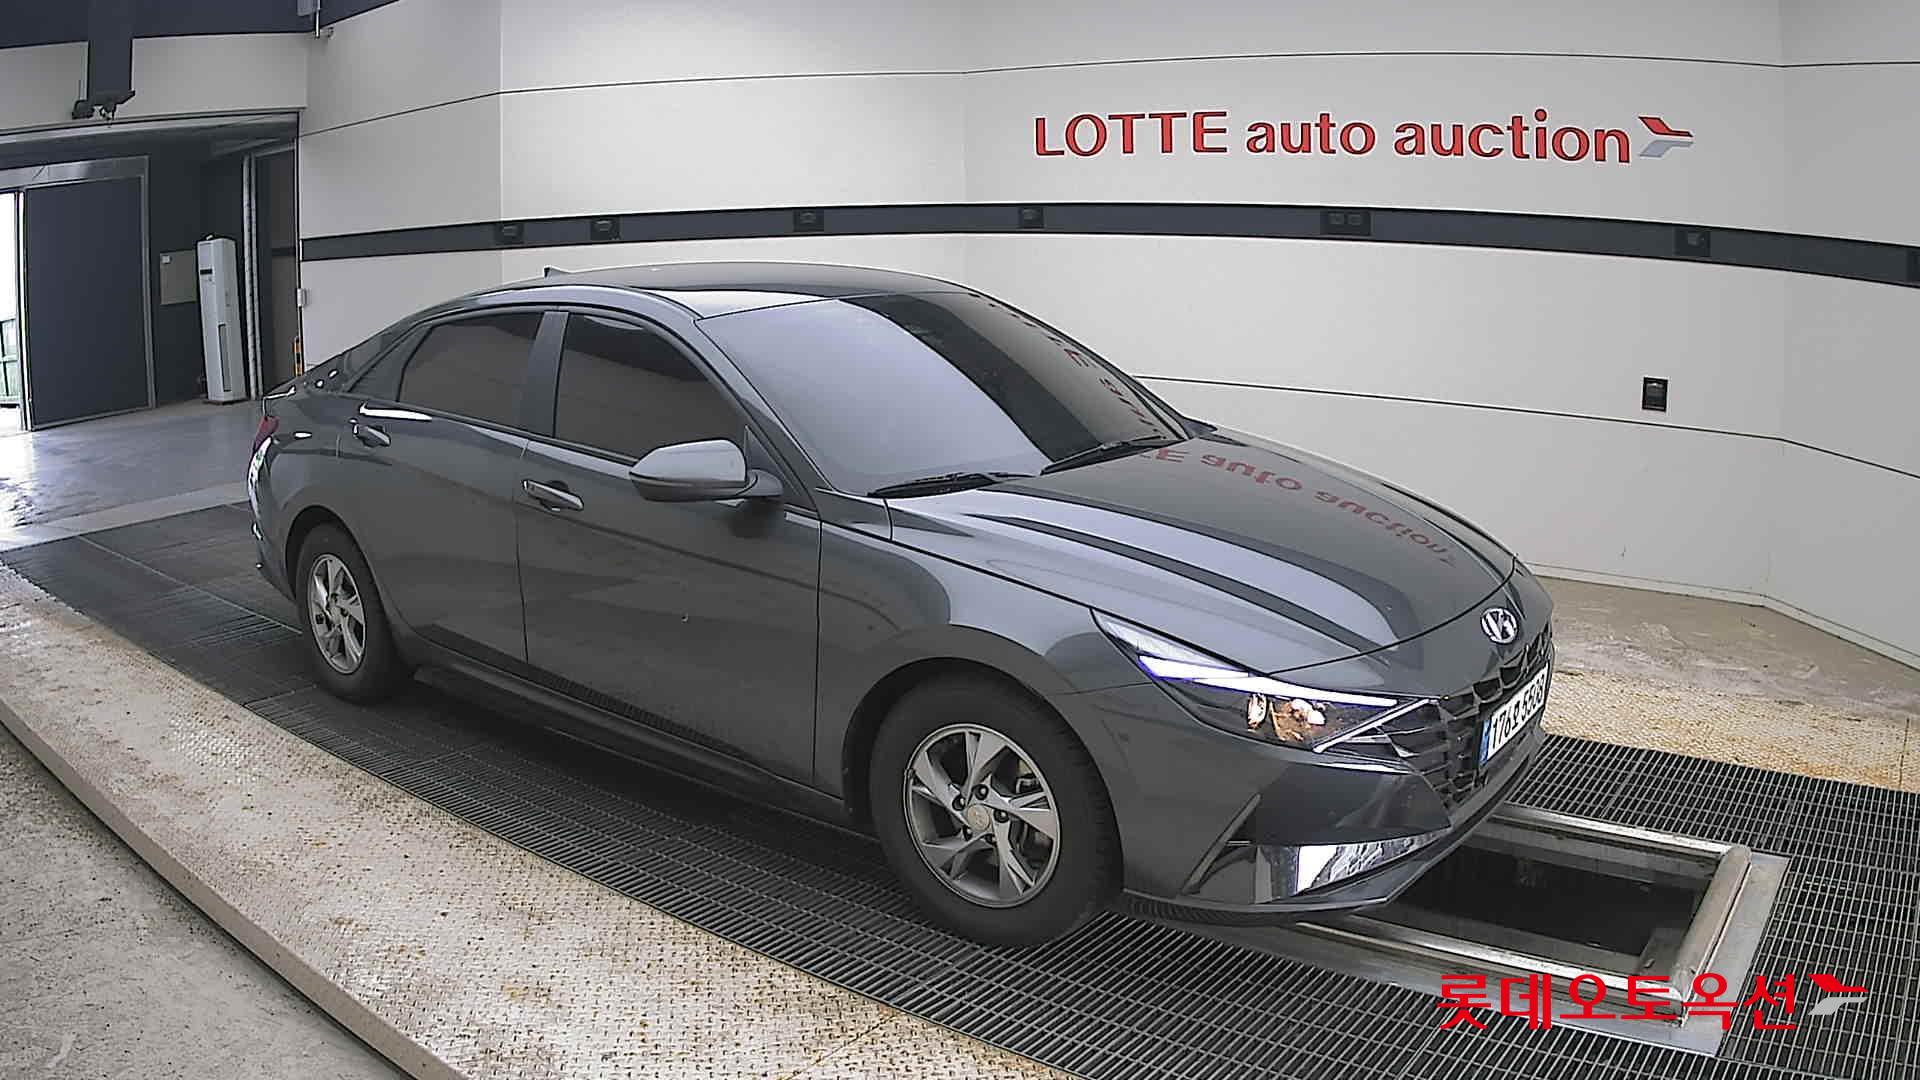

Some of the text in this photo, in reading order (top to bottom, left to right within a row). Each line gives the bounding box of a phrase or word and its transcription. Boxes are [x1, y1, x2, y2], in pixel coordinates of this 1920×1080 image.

[1035, 110, 1631, 163] LOTTE auto auction
